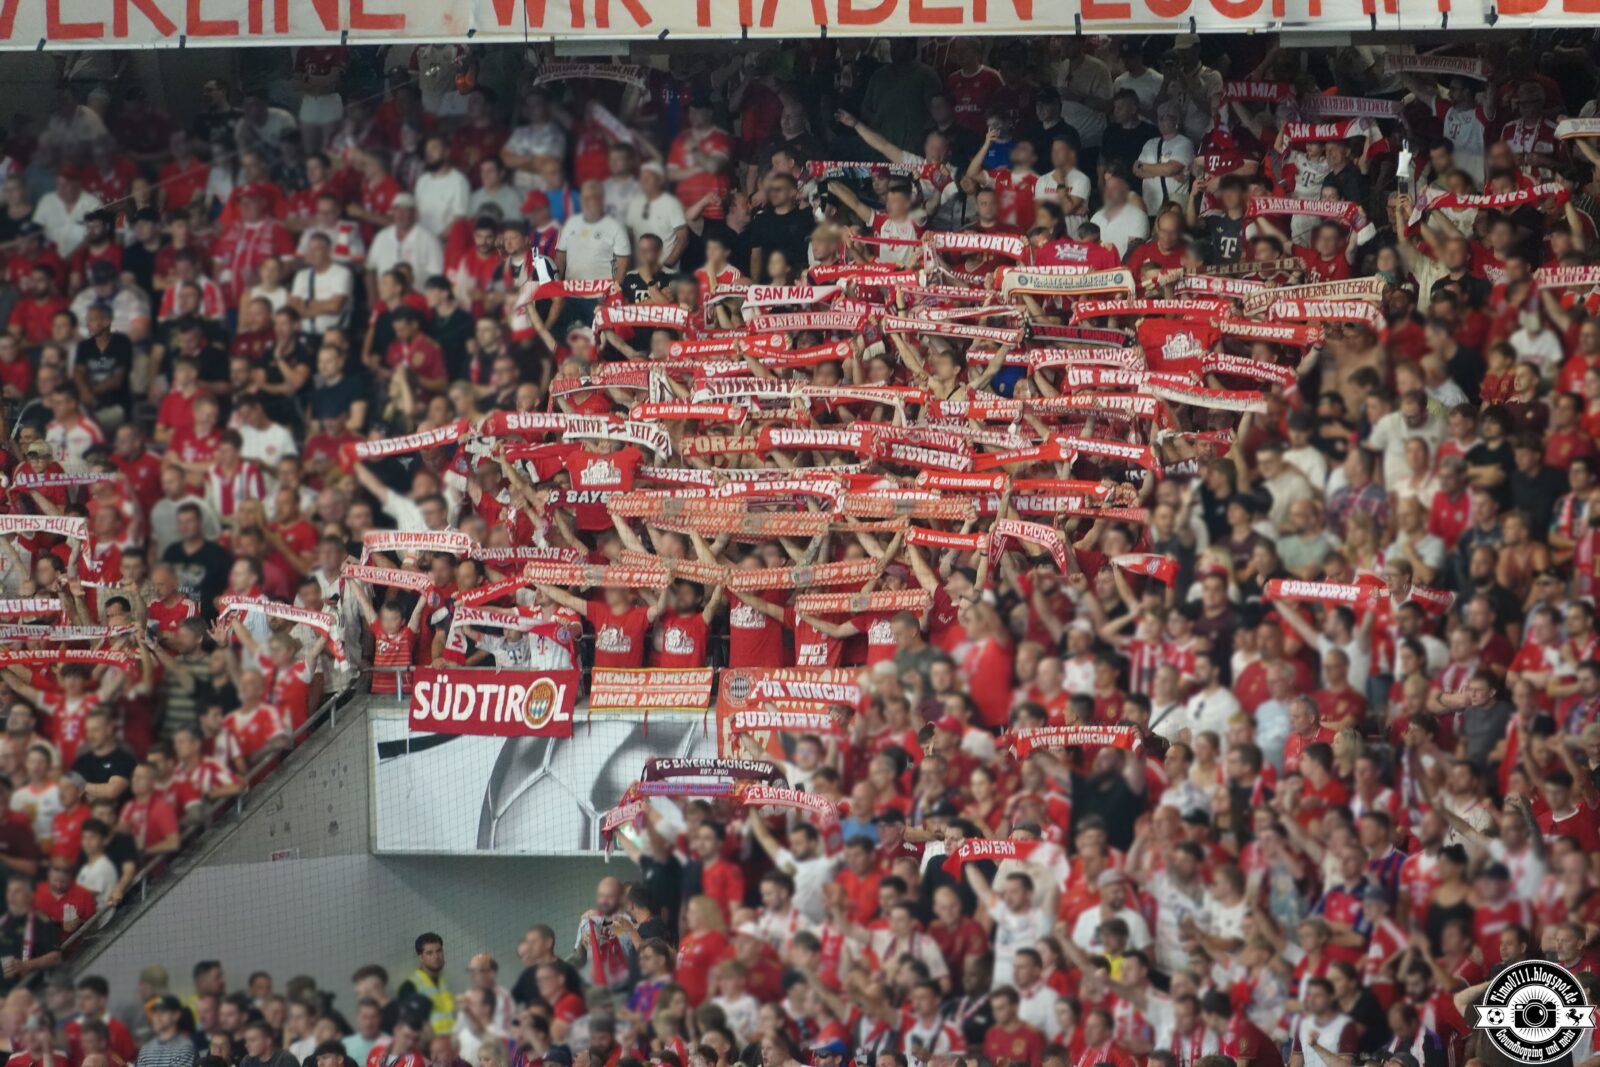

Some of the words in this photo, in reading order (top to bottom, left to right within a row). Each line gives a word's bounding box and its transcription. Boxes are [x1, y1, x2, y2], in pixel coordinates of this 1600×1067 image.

[1251, 83, 1277, 98] MIA
[1288, 123, 1311, 138] SAN
[1315, 123, 1338, 137] MIA
[1256, 197, 1267, 209] FC
[1269, 197, 1301, 210] BAYERN
[1456, 194, 1491, 205] MIA
[1495, 190, 1527, 204] SAN
[935, 233, 1024, 256] SÜDKURVE
[865, 274, 916, 286] BAYERN
[754, 286, 785, 301] SAN
[788, 286, 815, 300] MIA
[835, 299, 867, 314] SAN
[1081, 300, 1095, 314] FC
[1098, 299, 1148, 312] BAYERN
[754, 317, 767, 330] FC
[769, 315, 807, 329] BAYERN
[1045, 348, 1091, 362] BAYERN
[1218, 353, 1255, 367] Bayern
[1071, 396, 1093, 405] VON
[683, 435, 756, 455] FORZA
[987, 496, 1084, 513] MNCHEN
[516, 545, 561, 562] BAYERN
[561, 547, 578, 564] FC
[455, 606, 485, 622] SAN
[8, 650, 60, 660] BAYERN
[592, 693, 638, 706] IMMER
[1031, 735, 1065, 748] BAYERN
[655, 760, 671, 771] FC
[672, 758, 715, 770] BAYERN
[748, 787, 761, 799] FC
[762, 787, 798, 801] BAYERN
[972, 840, 1016, 855] BAYERN
